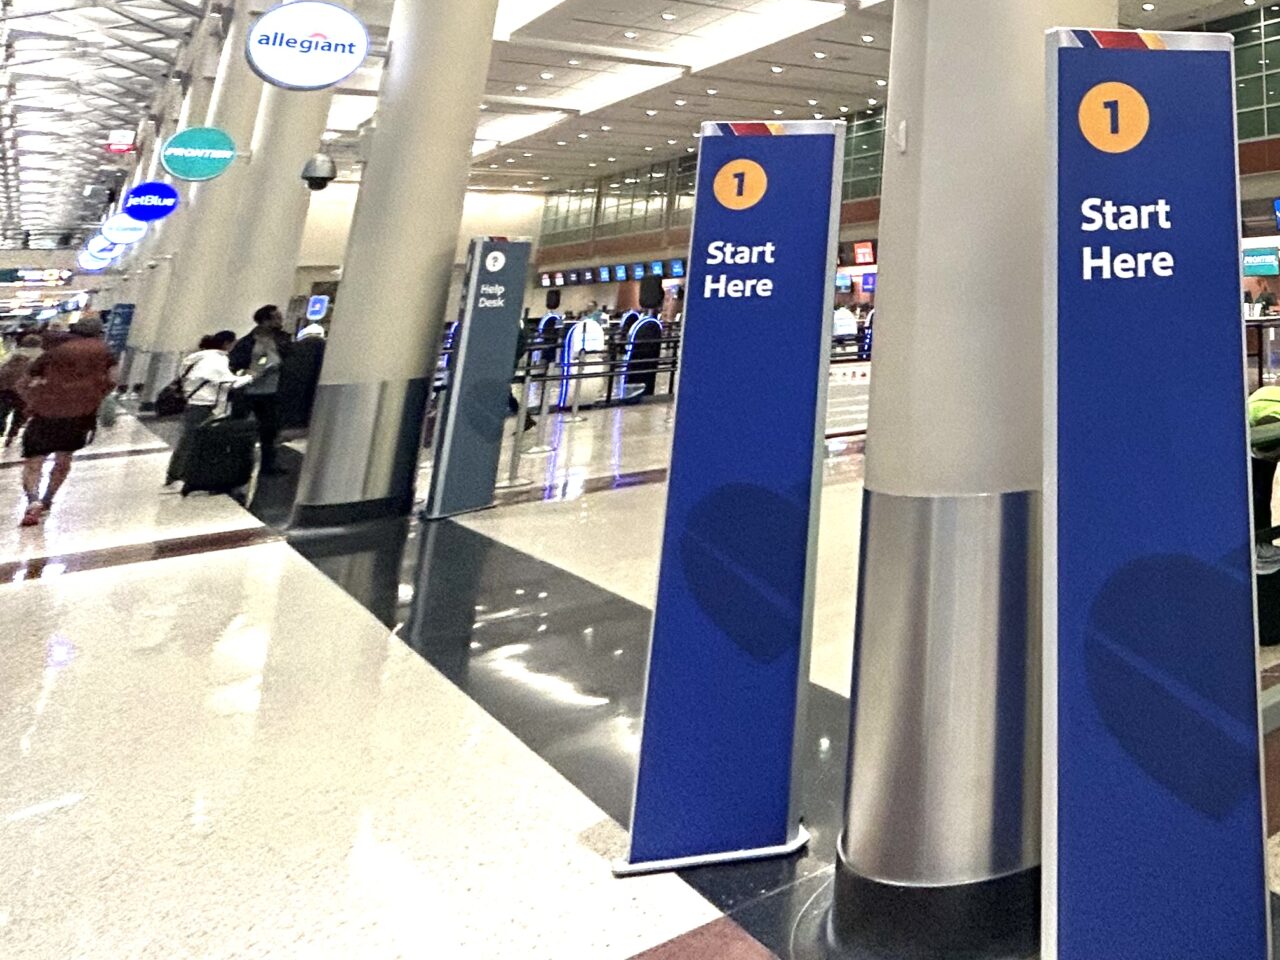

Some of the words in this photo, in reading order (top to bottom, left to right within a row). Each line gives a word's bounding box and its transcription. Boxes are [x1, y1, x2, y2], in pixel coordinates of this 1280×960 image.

[257, 31, 356, 54] allegiant
[1102, 99, 1120, 135] 1
[163, 147, 235, 159] FRONTIER
[732, 171, 746, 197] 1
[126, 194, 176, 207] jetBlue
[1080, 197, 1172, 231] Start
[706, 241, 775, 265] Start
[1082, 245, 1174, 280] Here
[480, 284, 505, 297] Help
[703, 274, 773, 298] Here
[478, 297, 505, 308] Desk
